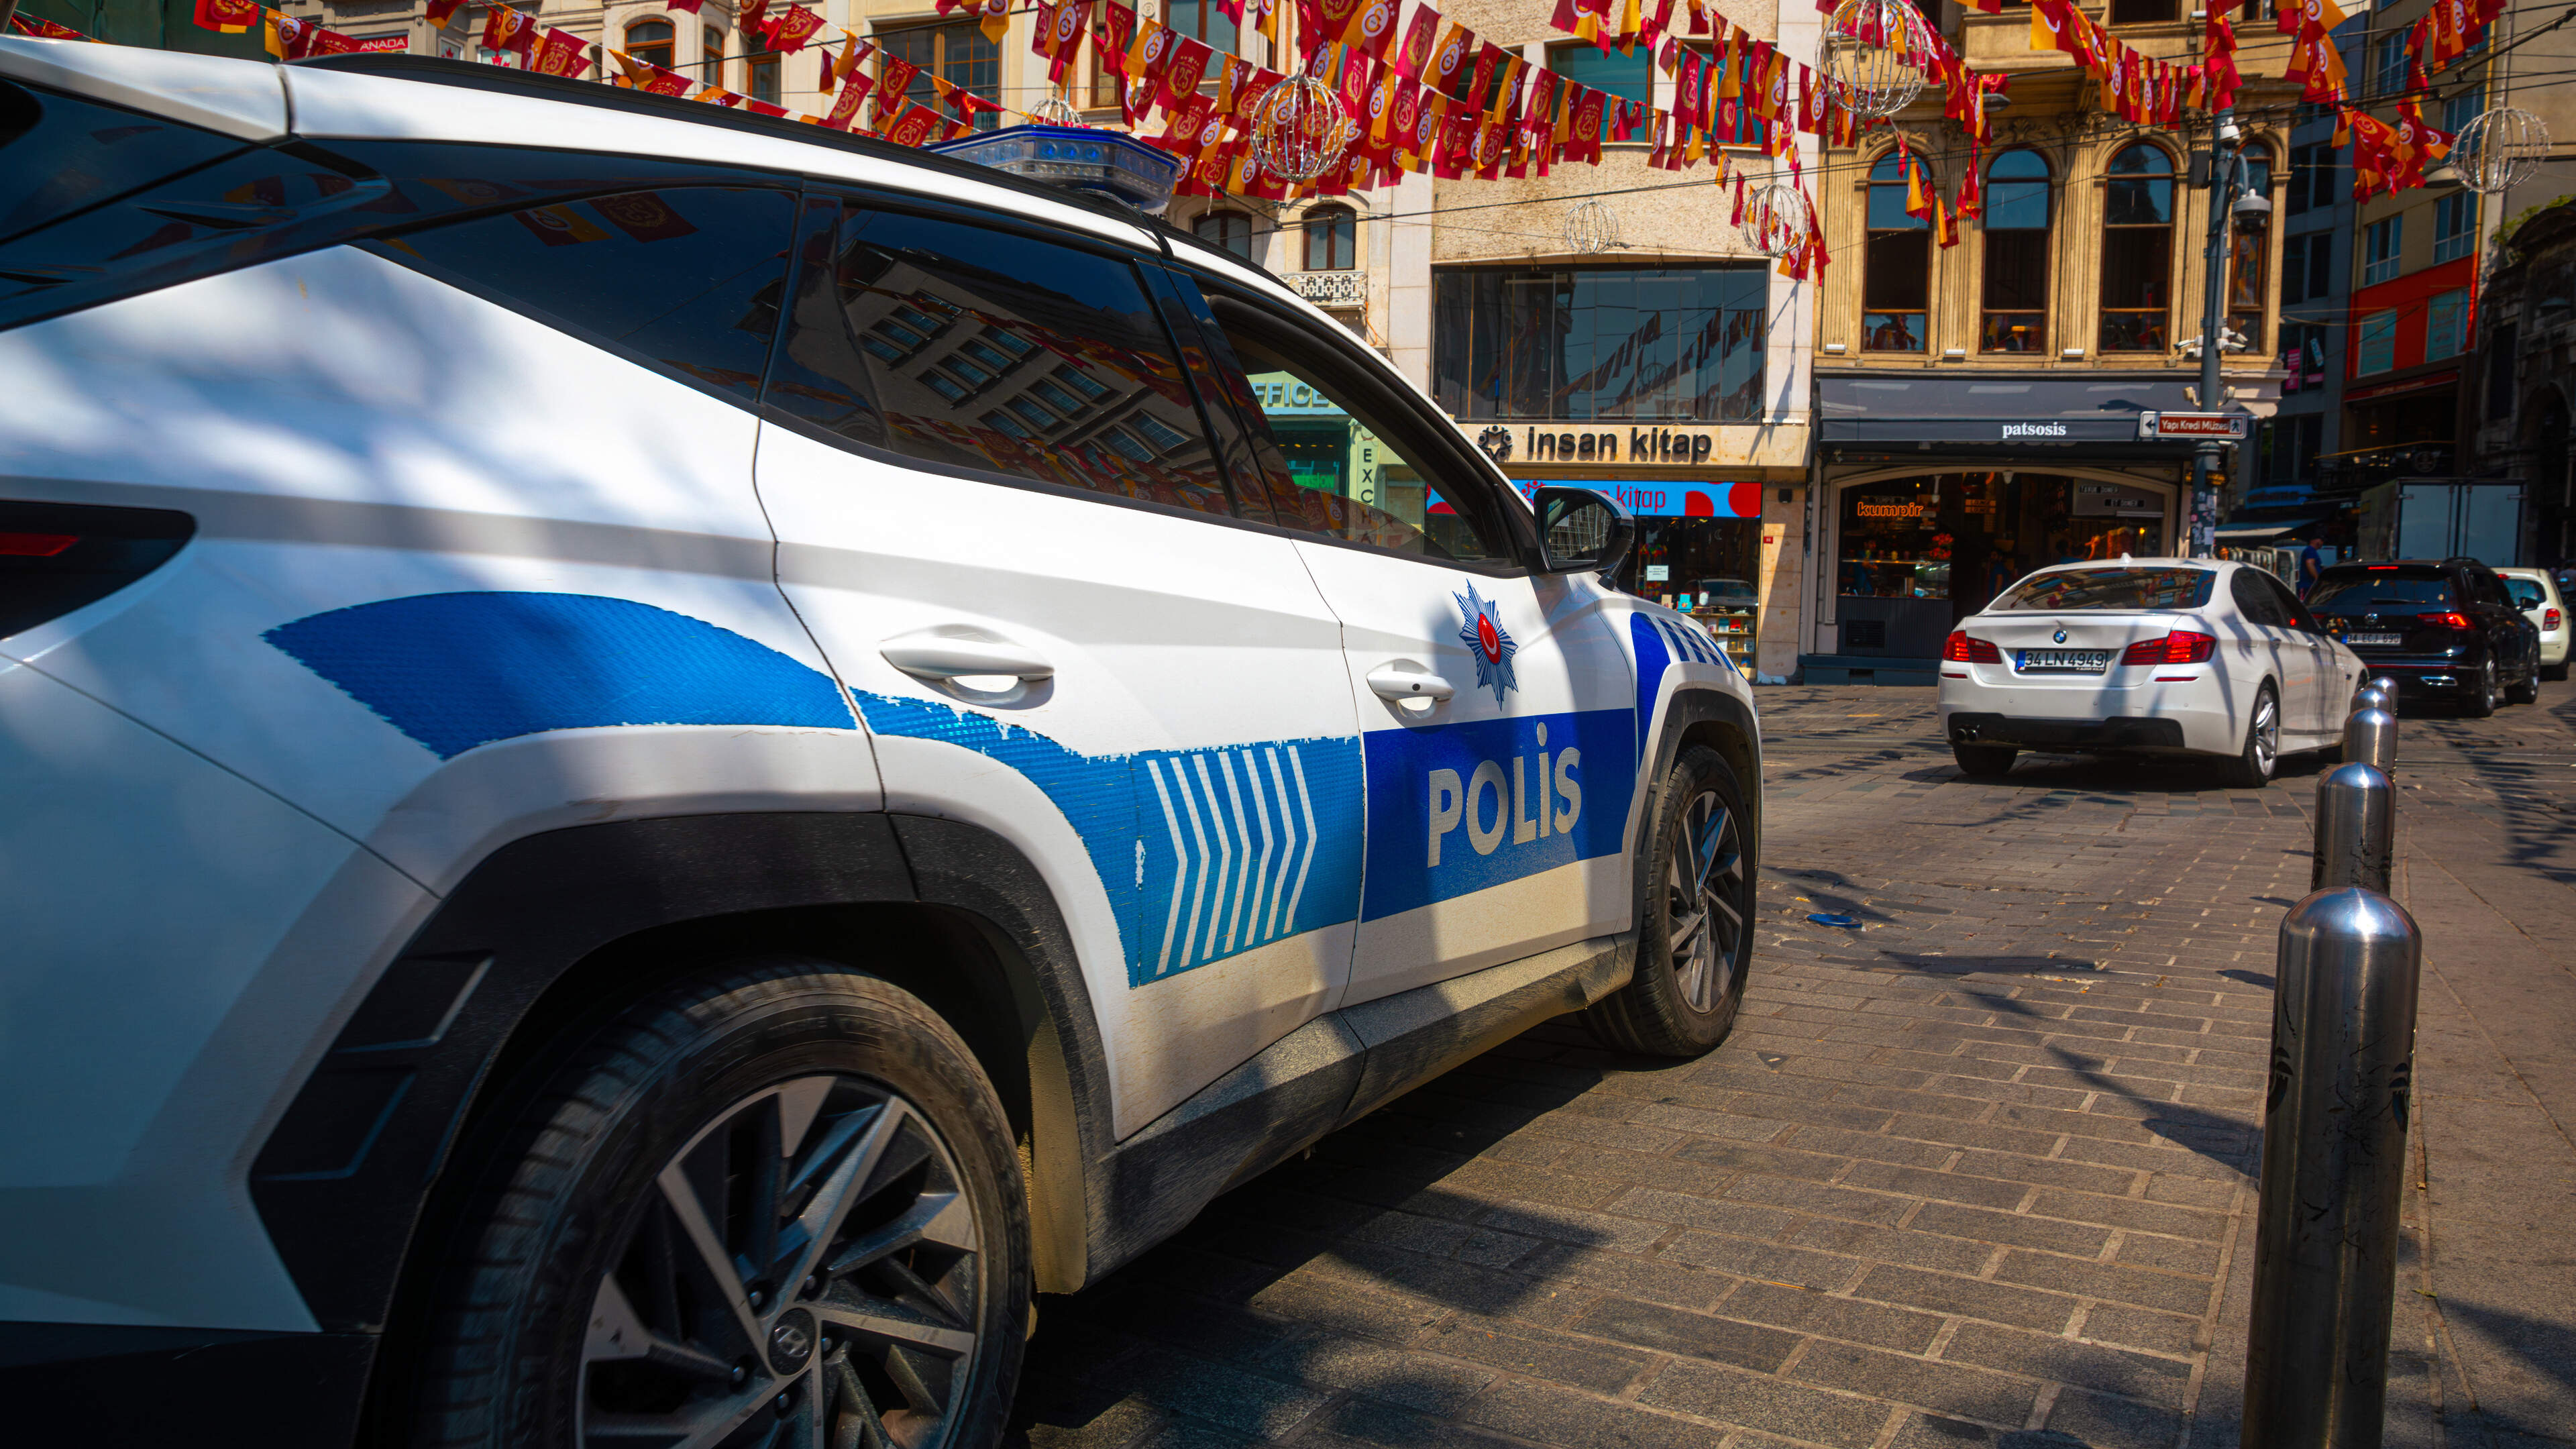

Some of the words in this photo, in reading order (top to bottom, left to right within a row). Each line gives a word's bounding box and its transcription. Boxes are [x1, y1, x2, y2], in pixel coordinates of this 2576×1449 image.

[789, 15, 806, 33] 25
[547, 50, 564, 66] 25
[1177, 67, 1193, 89] 25
[1582, 113, 1595, 132] 25
[1207, 162, 1222, 179] 25
[2002, 421, 2067, 439] patsosis
[2161, 420, 2179, 431] Yapı
[2181, 420, 2200, 430] Kredi
[2202, 420, 2229, 431] Müzesi
[1630, 427, 1712, 462] kitap
[1617, 484, 1666, 513] kitap
[1858, 502, 1924, 517] kumpir
[2026, 652, 2041, 665] 34
[2045, 652, 2065, 665] LN
[2068, 652, 2105, 666] 4949
[1427, 721, 1582, 869] POLİS
